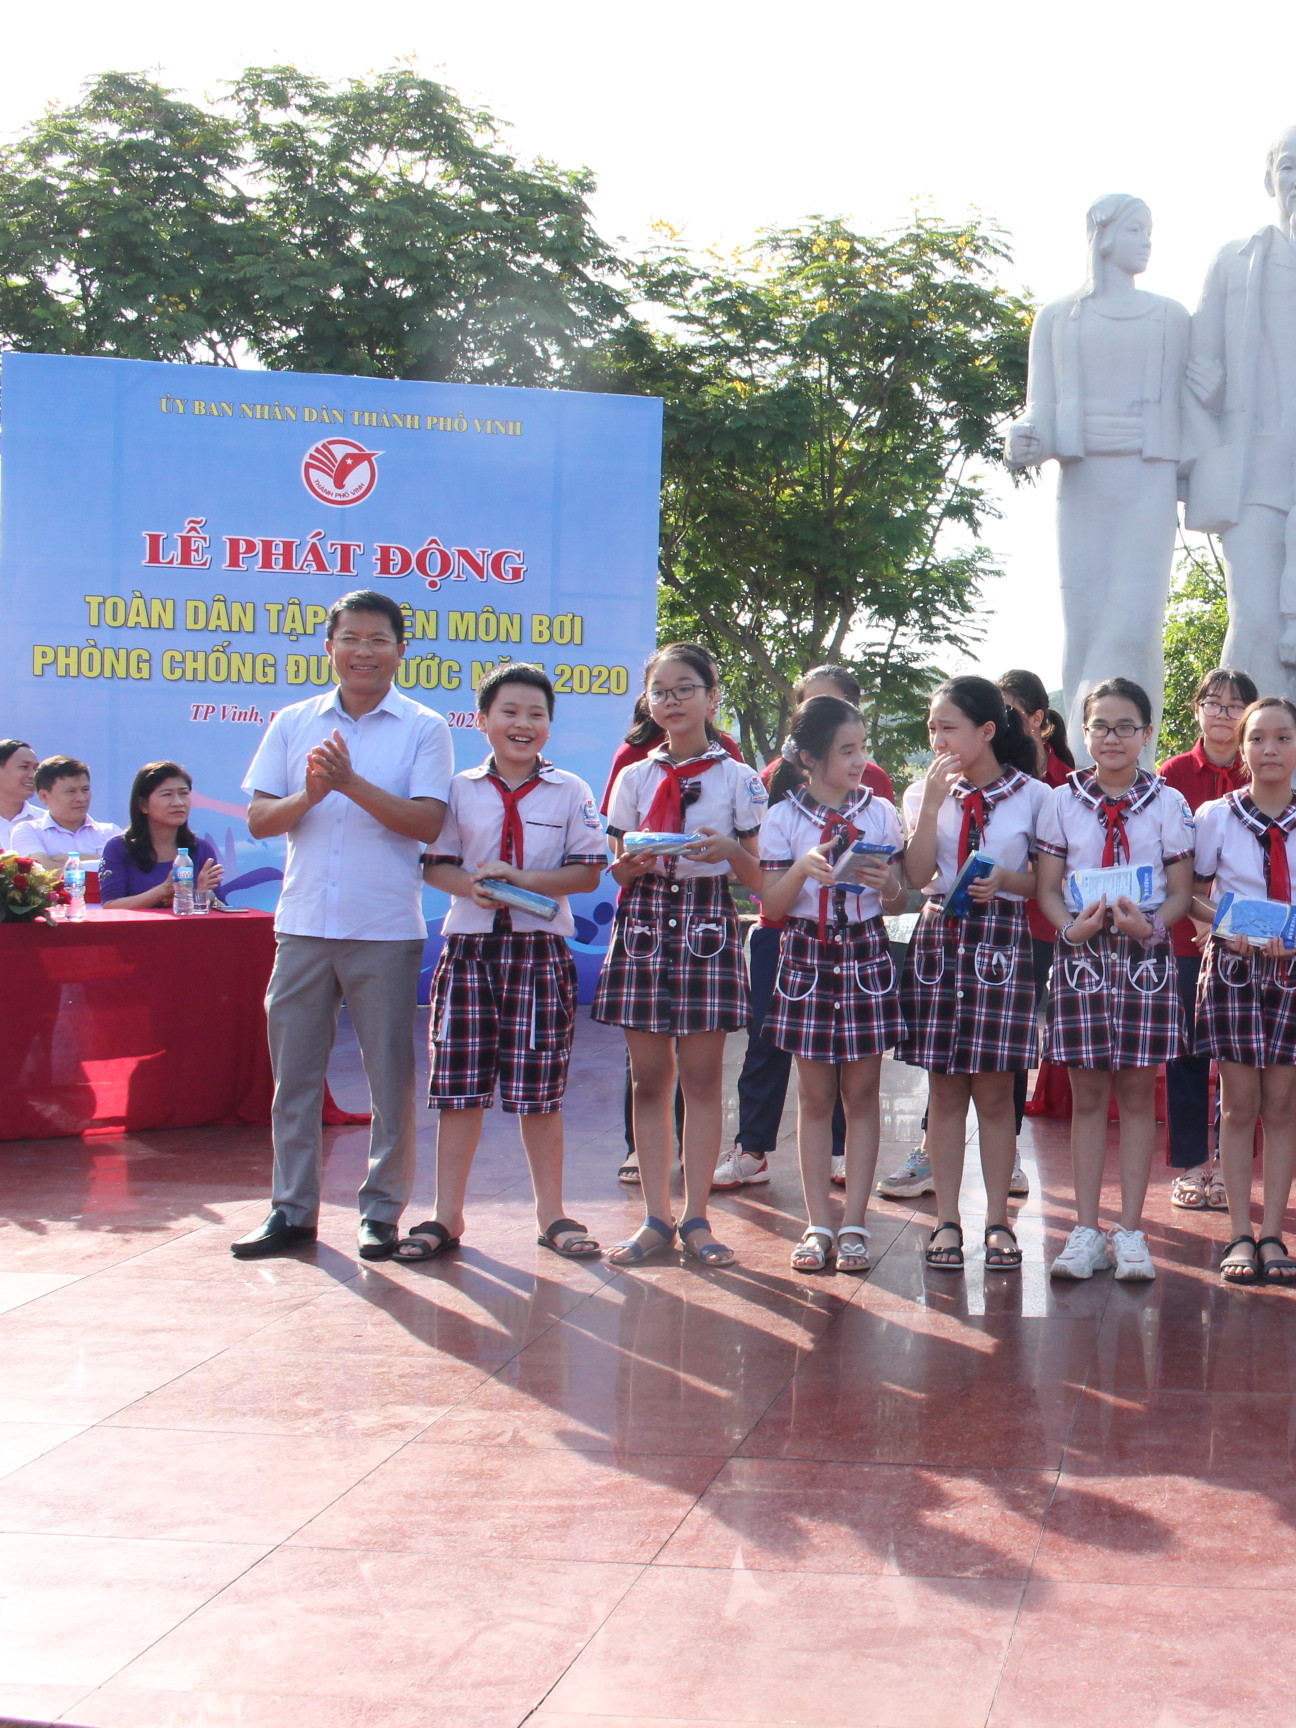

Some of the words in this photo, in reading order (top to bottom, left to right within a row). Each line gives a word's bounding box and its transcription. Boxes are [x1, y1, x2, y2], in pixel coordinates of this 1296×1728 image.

[160, 393, 188, 414] ỦY
[193, 400, 234, 417] BAN
[240, 402, 298, 421] NHÂN
[303, 404, 345, 424] DÂN
[351, 408, 420, 429] THÀNH
[426, 410, 468, 433] PHỐ
[474, 419, 523, 436] VINH
[142, 517, 211, 570] LỄ
[222, 530, 364, 577] PHÁT
[374, 537, 527, 592] ĐỘNG
[84, 590, 175, 629] TOÀN
[185, 594, 255, 632] DÂN
[265, 598, 326, 641] TẬP
[448, 606, 521, 643] MÔN
[531, 612, 583, 645] BƠI
[32, 639, 151, 680] PHÒNG
[161, 641, 276, 684] CHỐNG
[391, 653, 461, 690] ƯỚC
[553, 664, 629, 696] 2020
[190, 704, 216, 722] TP
[221, 705, 264, 726] Vinh,
[447, 711, 478, 728] 202
